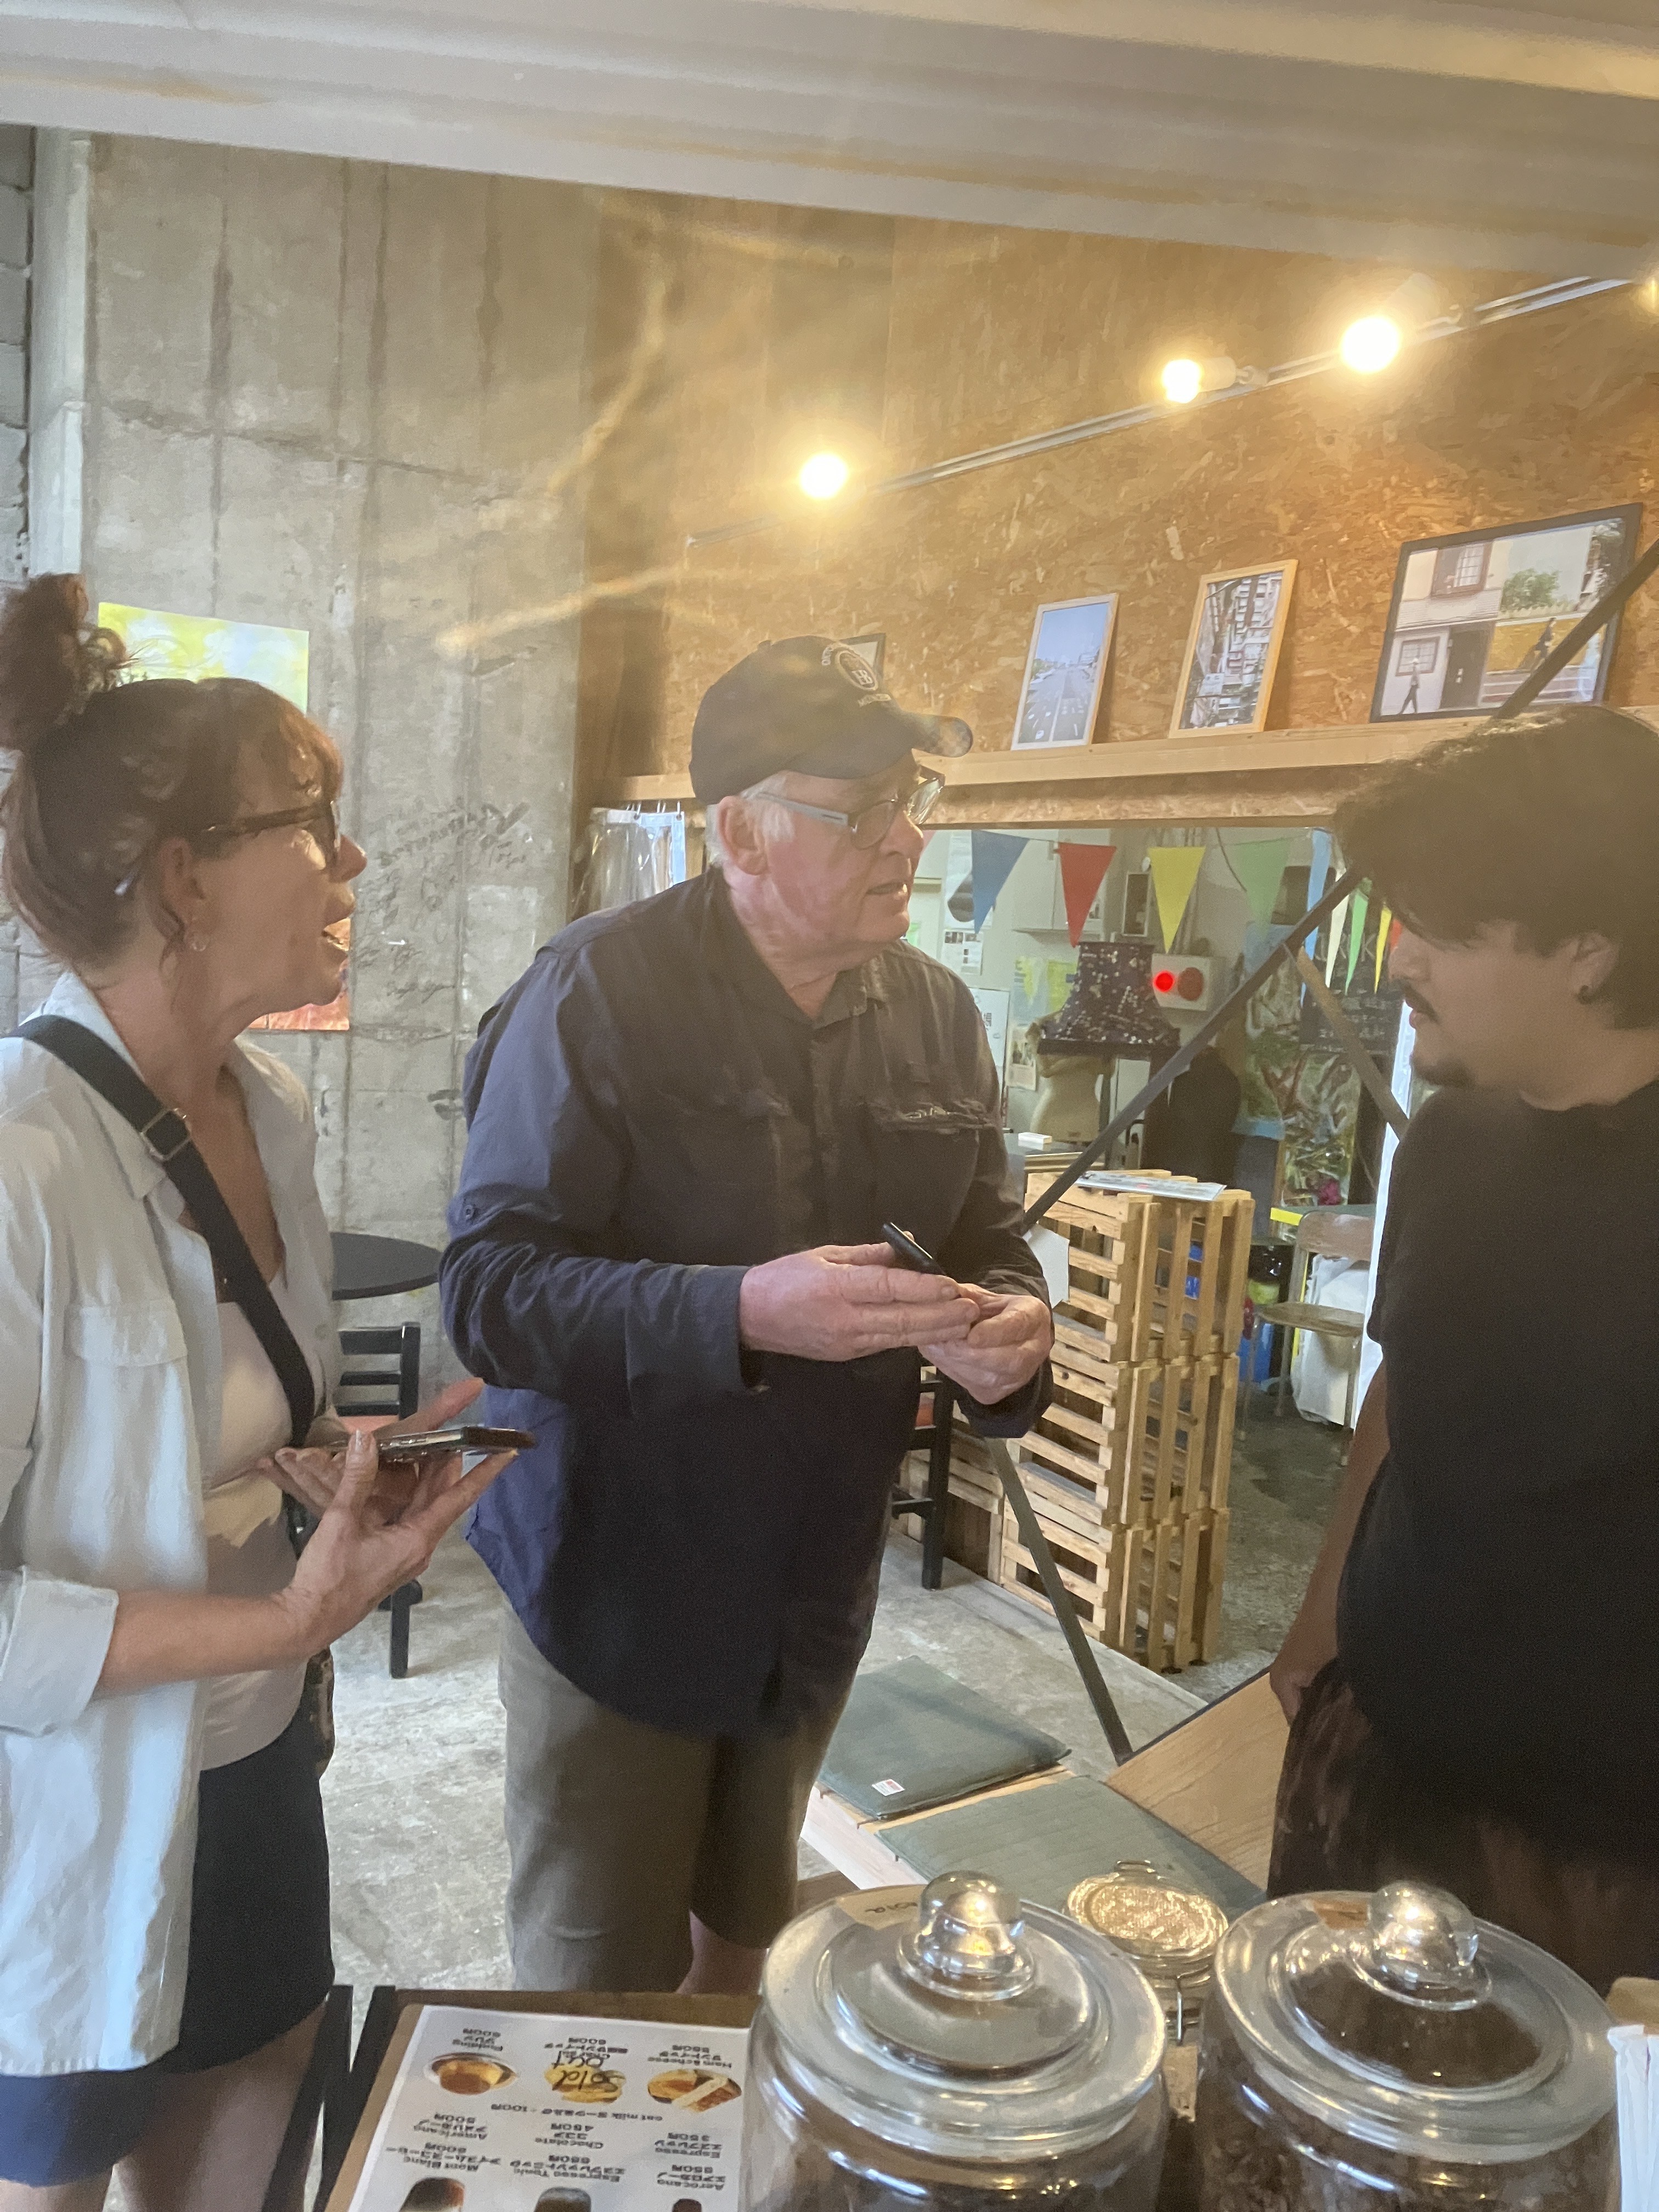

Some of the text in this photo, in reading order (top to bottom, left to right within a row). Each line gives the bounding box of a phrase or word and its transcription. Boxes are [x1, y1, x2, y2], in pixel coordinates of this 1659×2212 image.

[414, 2125, 488, 2140] Americano
[535, 2137, 603, 2149] Chocolate
[654, 2147, 721, 2158] Espresso
[443, 2162, 478, 2172] Mont
[554, 2170, 620, 2182] Espresso
